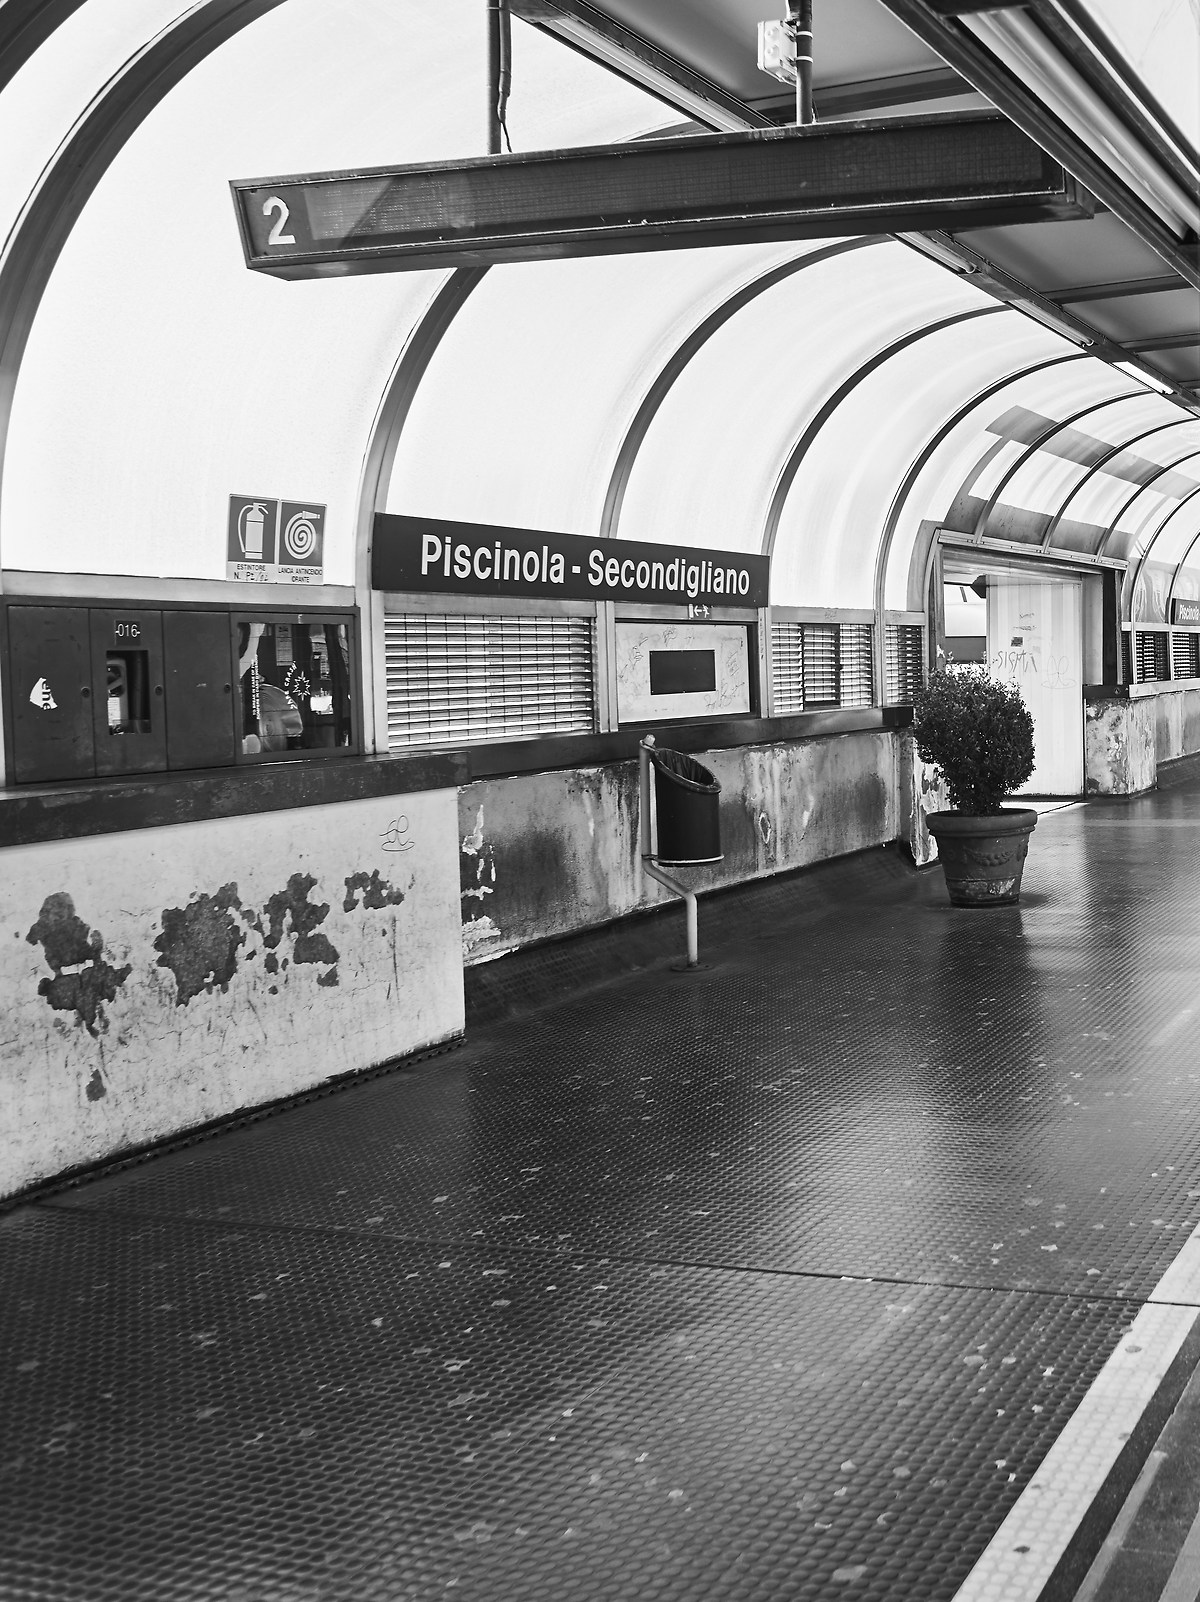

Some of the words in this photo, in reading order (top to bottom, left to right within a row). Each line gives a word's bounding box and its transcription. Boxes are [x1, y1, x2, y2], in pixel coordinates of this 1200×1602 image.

[262, 196, 296, 245] 2
[236, 563, 266, 572] ESTINTORE
[421, 534, 565, 584] Piscinola
[587, 550, 750, 597] Secondigliano
